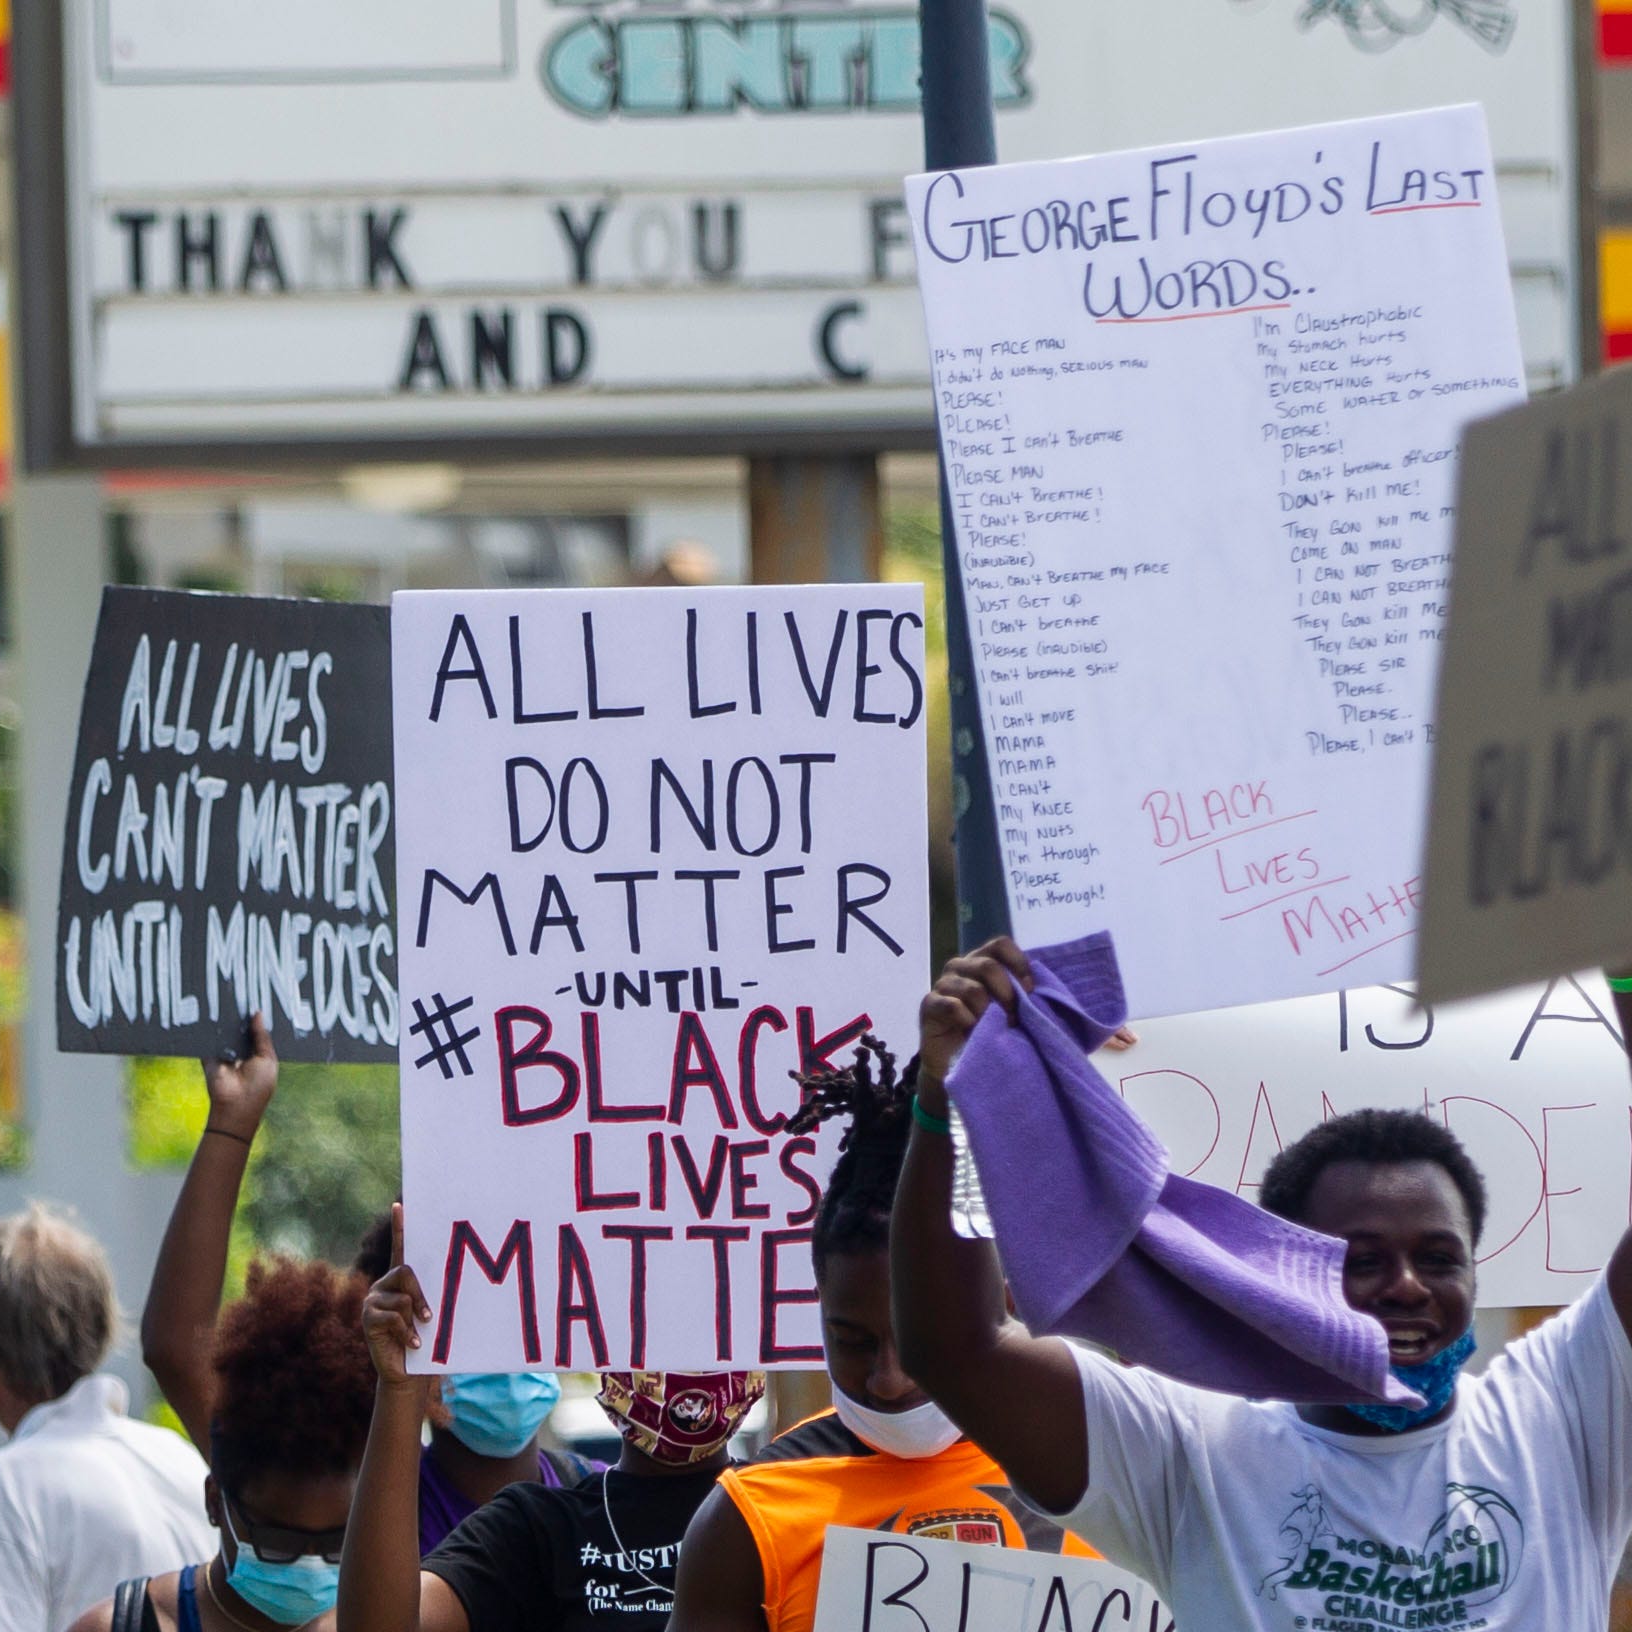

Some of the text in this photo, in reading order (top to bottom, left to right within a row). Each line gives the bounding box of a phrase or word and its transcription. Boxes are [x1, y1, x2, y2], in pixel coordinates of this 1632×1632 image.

[923, 172, 1141, 264] GEORGE
[1365, 141, 1484, 212] LAST
[553, 200, 744, 283] YOU
[1253, 316, 1281, 338] I'm
[396, 304, 594, 390] AND
[991, 340, 1030, 357] FACE
[1060, 358, 1114, 373] SERIOUS
[1299, 359, 1339, 374] NECK
[1270, 377, 1373, 399] EVERYTHING
[942, 389, 1004, 410] PLEASE!
[1274, 401, 1327, 420] SOME
[943, 412, 1011, 434] PLEASE!
[1011, 464, 1044, 480] MAN
[1290, 546, 1329, 563] COME
[1134, 562, 1170, 576] FACE
[1314, 563, 1381, 583] CAN NOT
[975, 596, 1051, 614] JUST GET
[1312, 586, 1378, 606] CAN NOT
[428, 607, 925, 730] ALL LIVES
[1379, 657, 1407, 672] SIR
[117, 633, 333, 775] ALL LIVES
[995, 735, 1047, 754] MAMA
[998, 758, 1057, 778] MAMA
[505, 751, 838, 857] DO NOT
[1033, 802, 1074, 816] KNEE
[1141, 781, 1273, 848] BLACK
[77, 757, 390, 918] CAN'T MATTER
[1041, 845, 1101, 866] through
[1216, 847, 1321, 894] LIVES
[415, 861, 906, 957] MATTER
[65, 900, 200, 1030] UNTIL
[573, 1130, 823, 1226] LIVES
[960, 1527, 993, 1542] GUN
[584, 1578, 620, 1598] for
[1325, 1595, 1469, 1631] CHALLENGE
